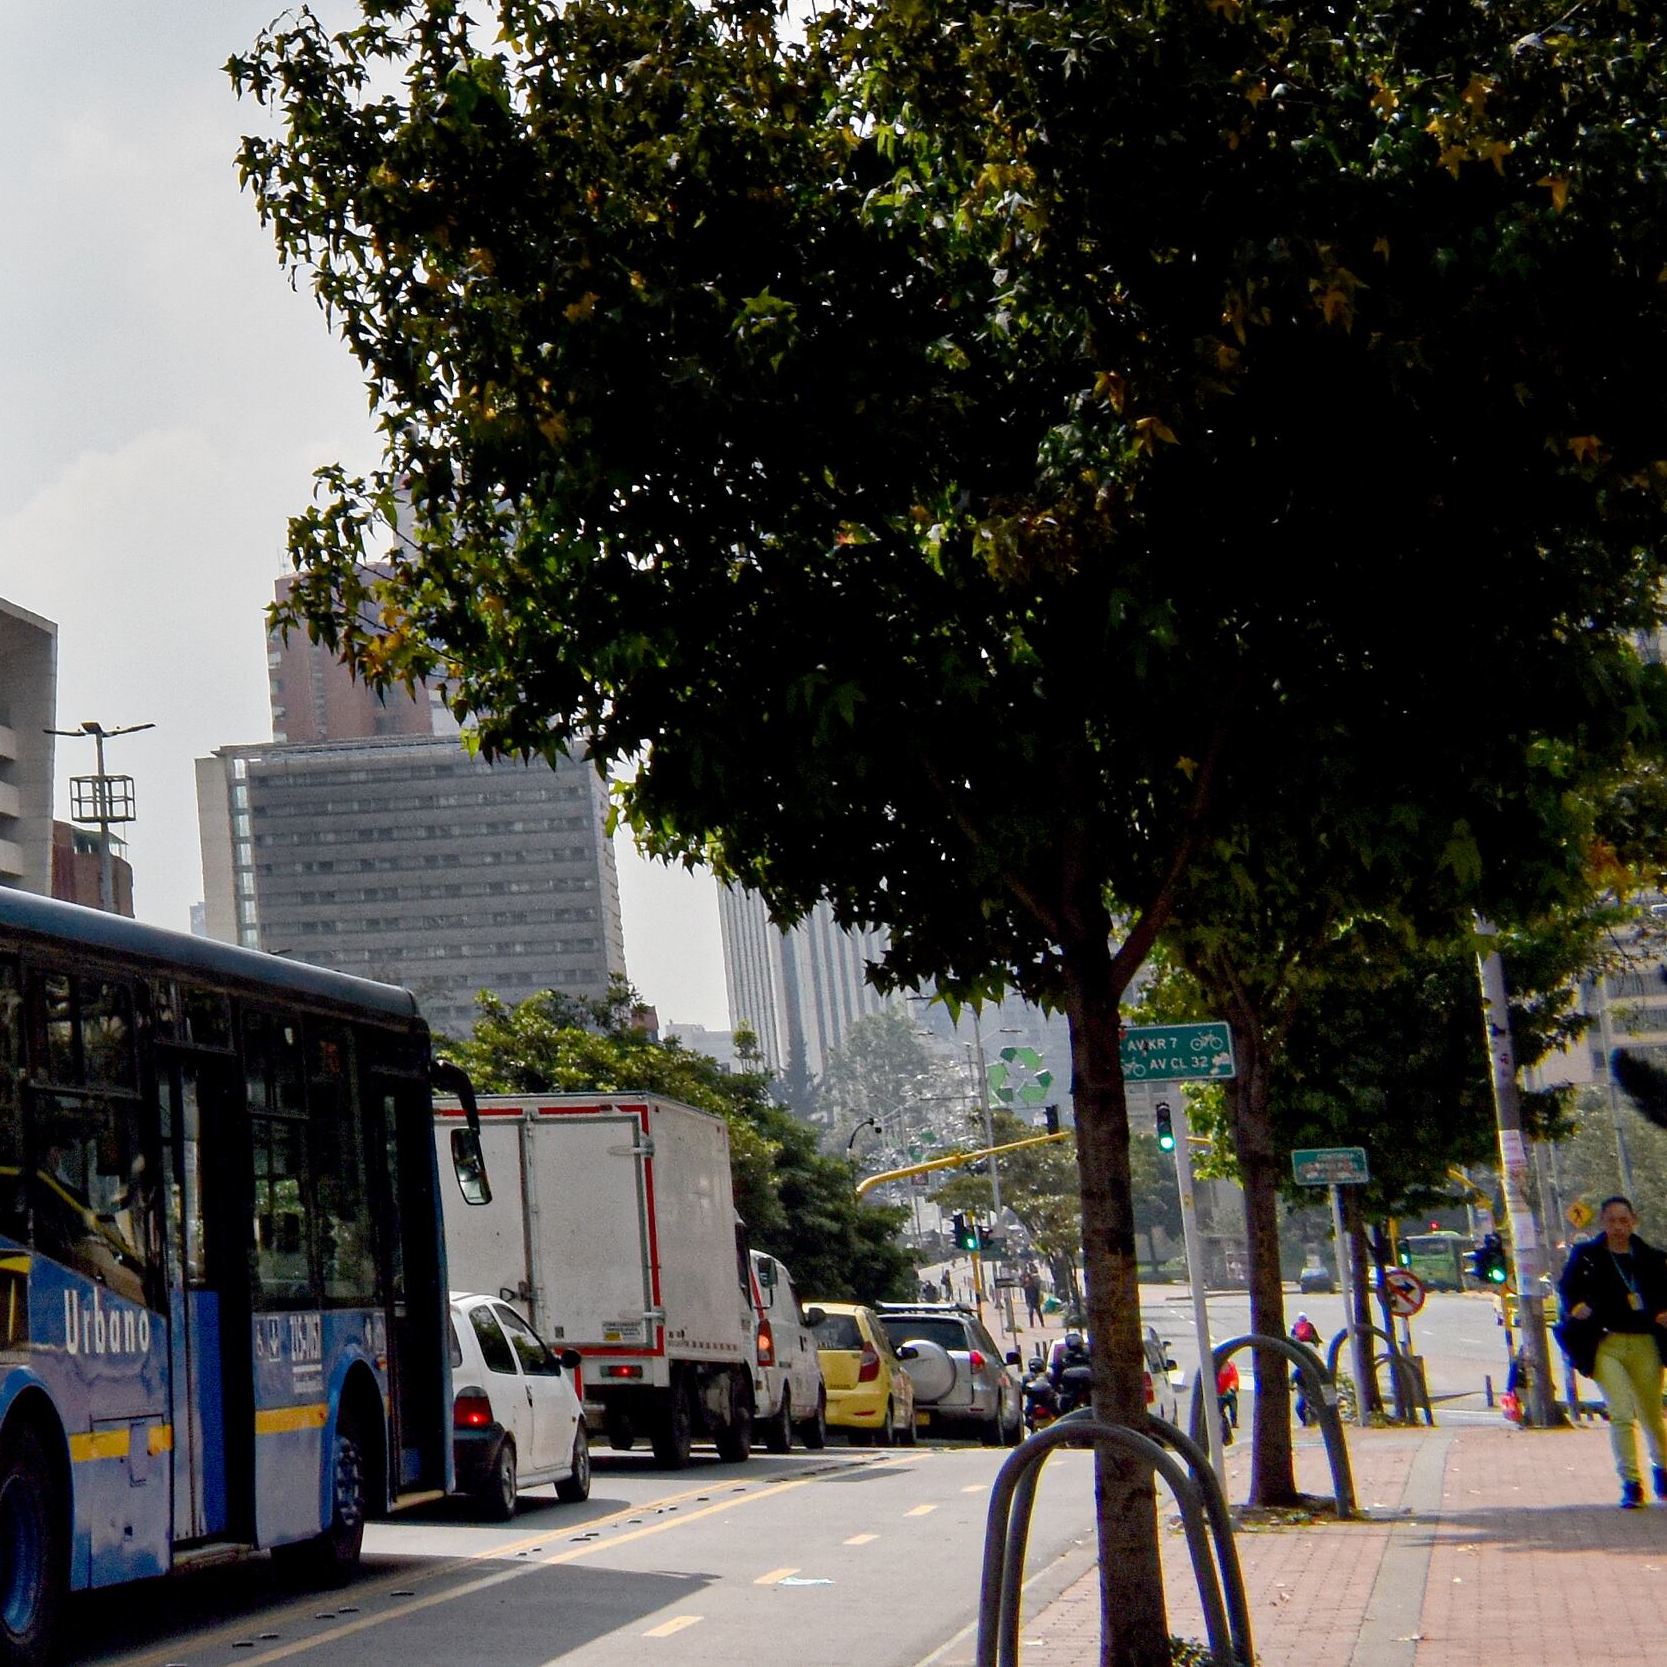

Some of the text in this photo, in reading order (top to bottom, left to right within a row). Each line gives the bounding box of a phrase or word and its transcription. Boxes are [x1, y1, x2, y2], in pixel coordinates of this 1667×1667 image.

[1127, 1037, 1178, 1052] AV KR 7
[1150, 1055, 1209, 1070] AV CL 32
[64, 1286, 150, 1355] Urbano
